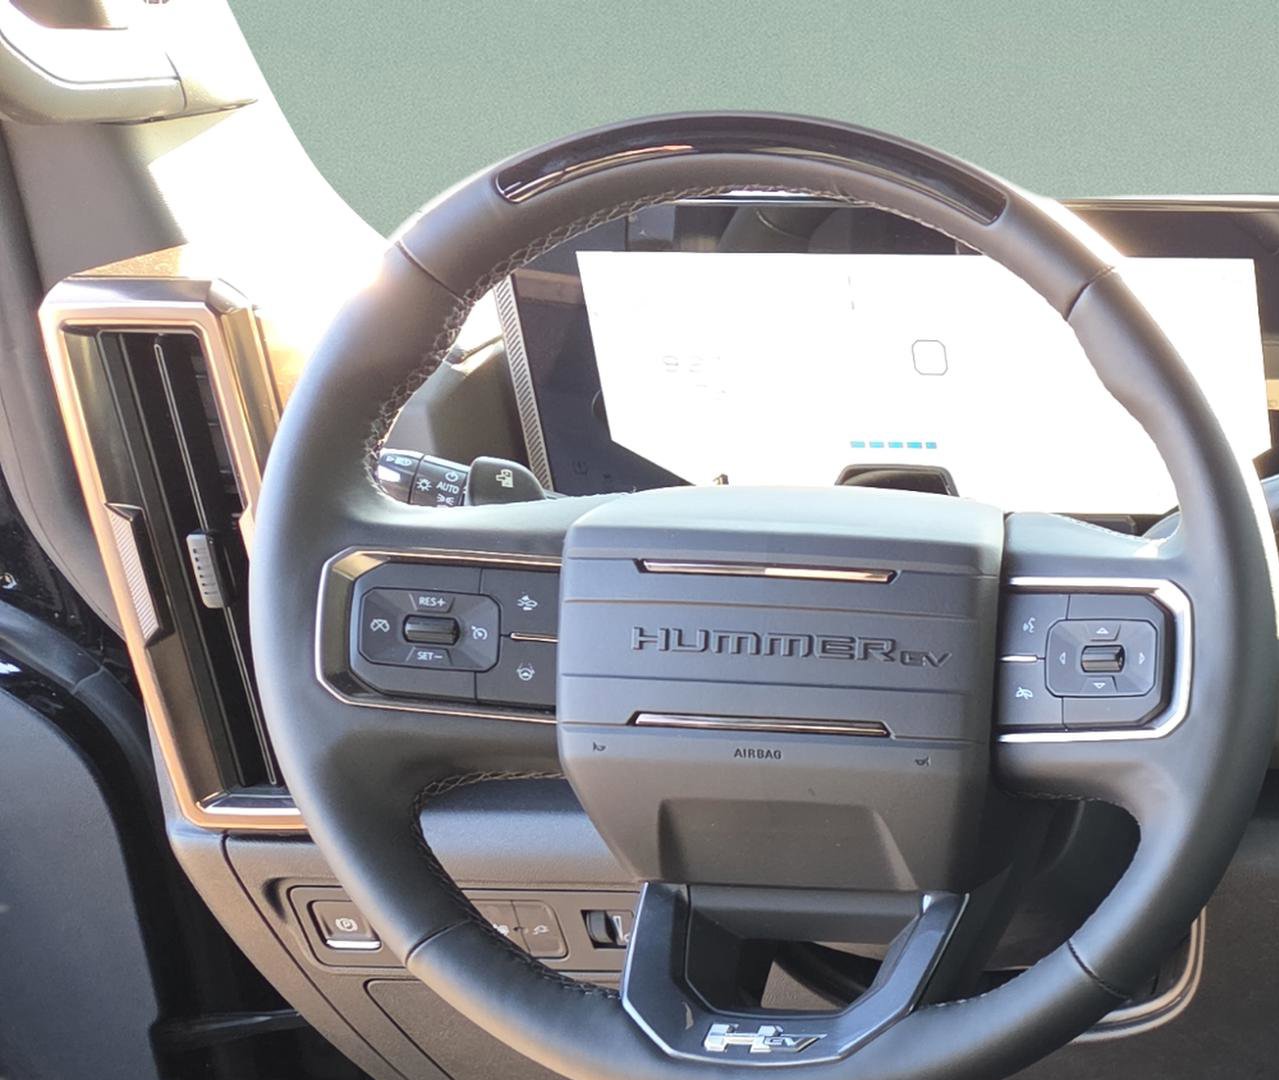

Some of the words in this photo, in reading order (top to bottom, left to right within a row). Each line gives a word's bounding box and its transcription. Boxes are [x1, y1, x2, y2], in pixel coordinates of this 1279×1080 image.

[436, 481, 460, 494] AUTO
[419, 596, 446, 607] RES+
[632, 627, 896, 661] HUMMER
[900, 651, 952, 667] EV
[734, 748, 782, 760] AIRBAG
